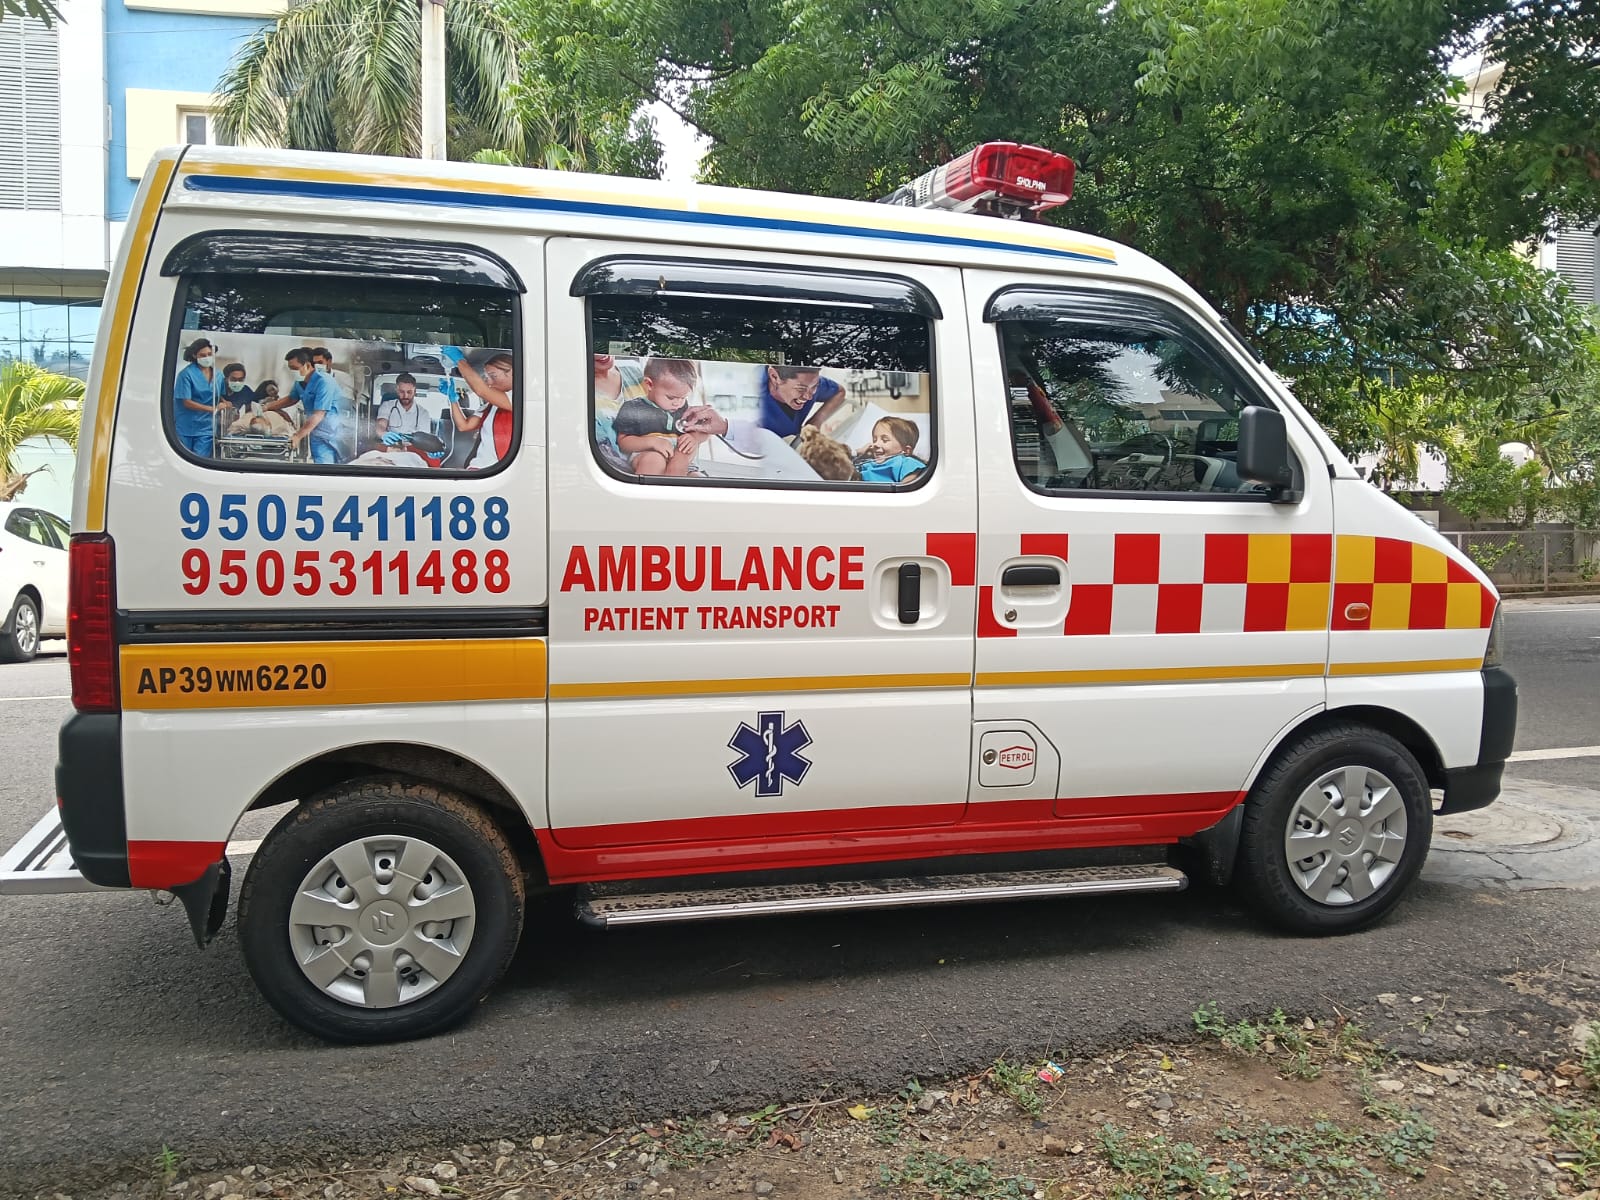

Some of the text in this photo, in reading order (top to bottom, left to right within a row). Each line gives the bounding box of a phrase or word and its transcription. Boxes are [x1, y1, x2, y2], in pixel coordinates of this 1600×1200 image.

[180, 492, 510, 542] 9505411188
[181, 548, 511, 597] 9505311488
[560, 545, 865, 593] AMBULANCE
[584, 604, 842, 632] PATIENT TRANSPORT
[137, 663, 327, 694] AP39WM6220
[1001, 752, 1032, 763] PETROL
